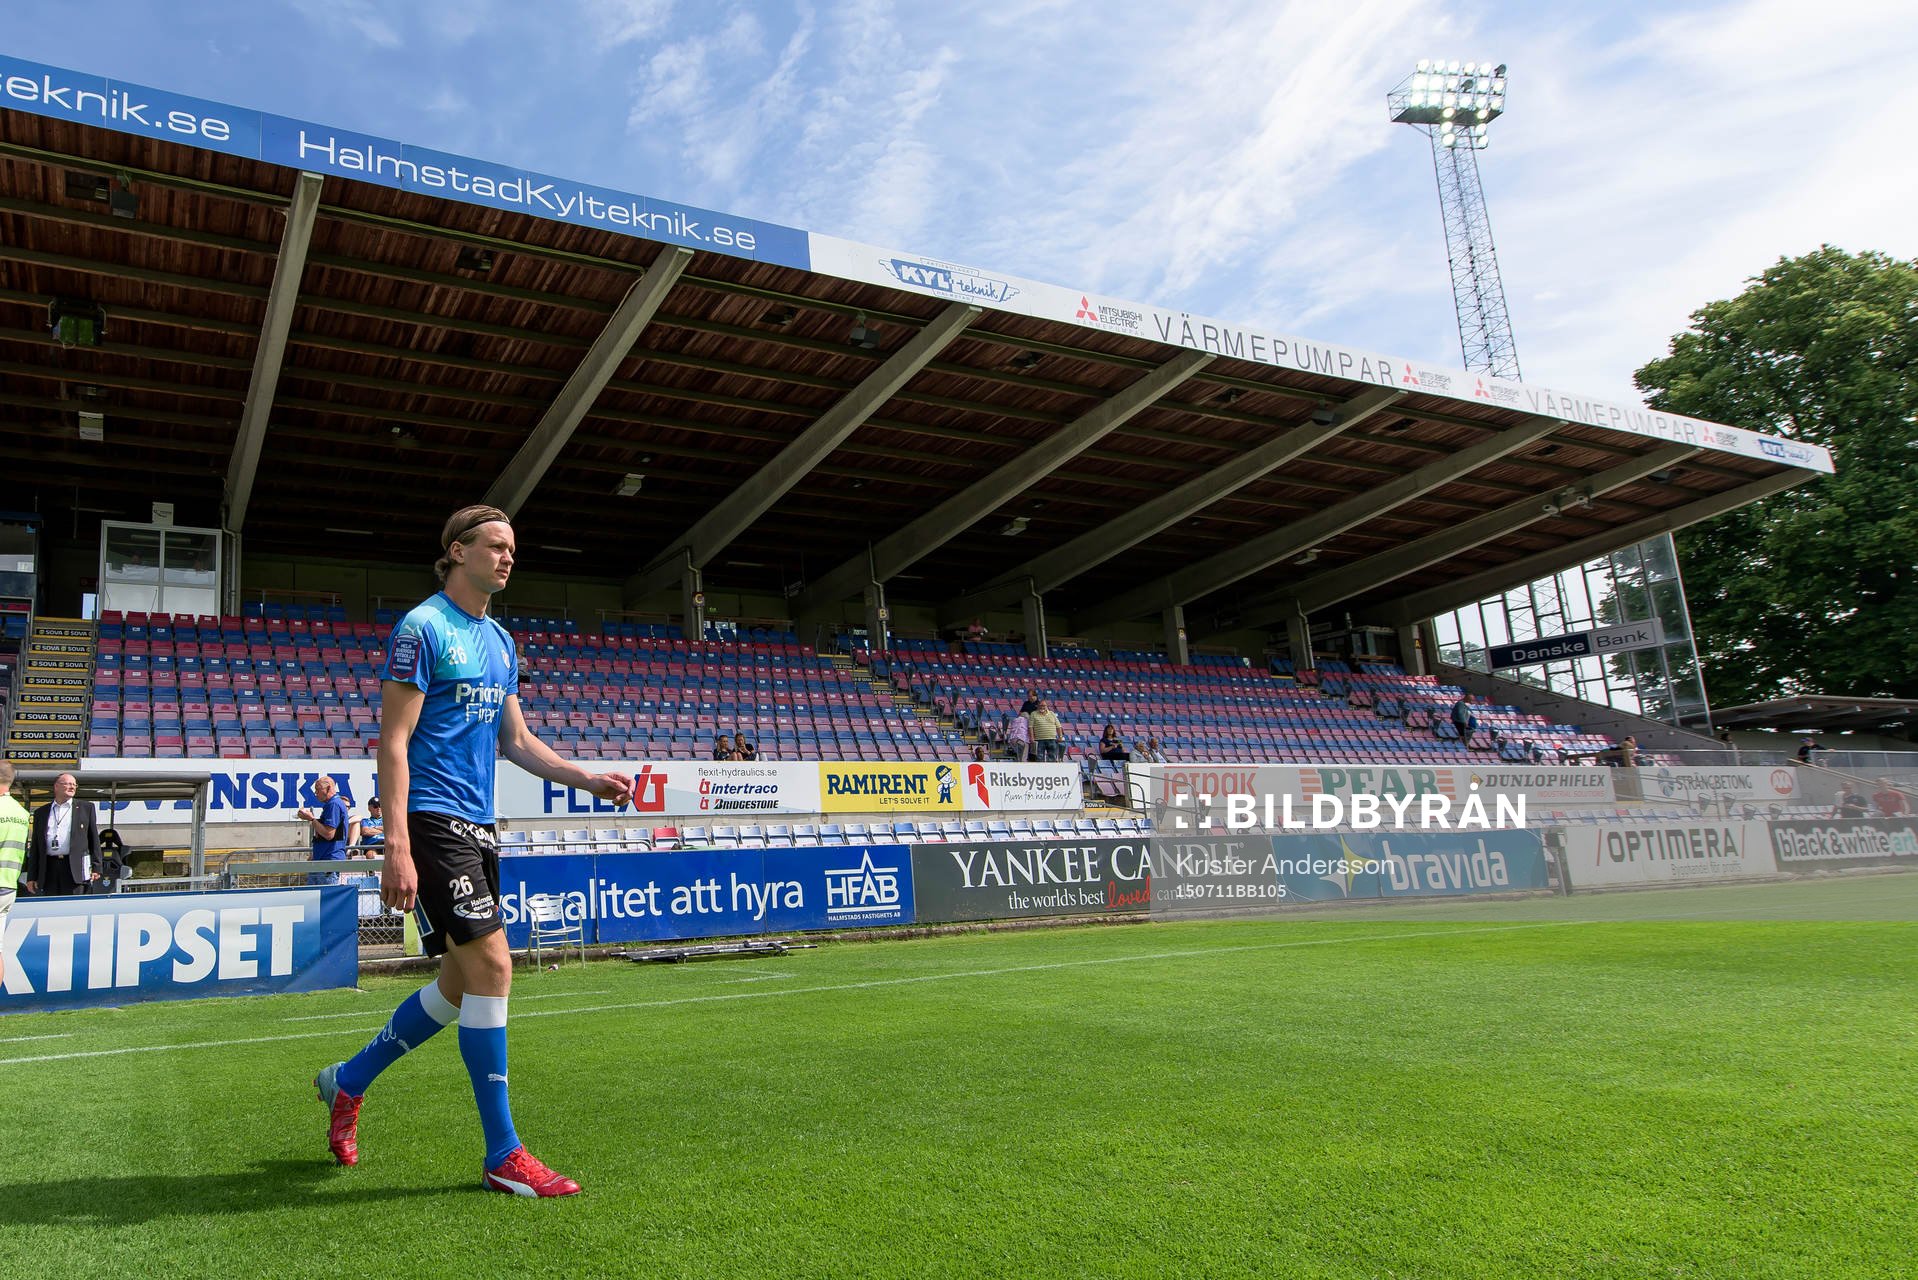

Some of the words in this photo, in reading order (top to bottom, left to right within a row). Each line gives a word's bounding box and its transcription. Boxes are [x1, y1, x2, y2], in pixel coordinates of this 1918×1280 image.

[0, 73, 230, 141] eknik.se
[299, 130, 756, 250] HalmstadKylteknik.se
[1098, 305, 1143, 322] MITSUBISHI
[1100, 315, 1138, 329] ELECTRIC
[1154, 312, 1395, 386] VÄRMEPUMPAR
[1526, 388, 1698, 444] VÄRMEPUMPAR
[448, 646, 467, 665] 26
[1512, 641, 1585, 662] Danske
[1596, 630, 1649, 648] Bank
[698, 768, 777, 778] flexit-hydraulics.se
[711, 783, 778, 794] intertraco
[827, 774, 928, 795] RAMIRENT
[990, 772, 1070, 790] Riksbyggen
[1163, 772, 1257, 806] jetpak
[1485, 775, 1557, 787] DUNLOP
[1559, 774, 1605, 787] HIFLEX
[99, 772, 356, 811] NSKA
[714, 799, 779, 809] BRIDGESTONE
[1607, 828, 1738, 863] OPTIMERA
[1778, 829, 1890, 858] black&white
[951, 847, 1101, 888] YANKEE
[1382, 839, 1510, 891] bravida
[449, 875, 474, 900] 26
[498, 879, 660, 924] skalitet
[671, 878, 722, 914] att
[730, 873, 804, 921] hyra
[826, 871, 900, 906] HFAB
[1008, 891, 1029, 909] the
[1032, 889, 1077, 907] world's
[1079, 887, 1104, 905] best
[1104, 875, 1151, 908] loved
[828, 913, 861, 921] HALMSTADS
